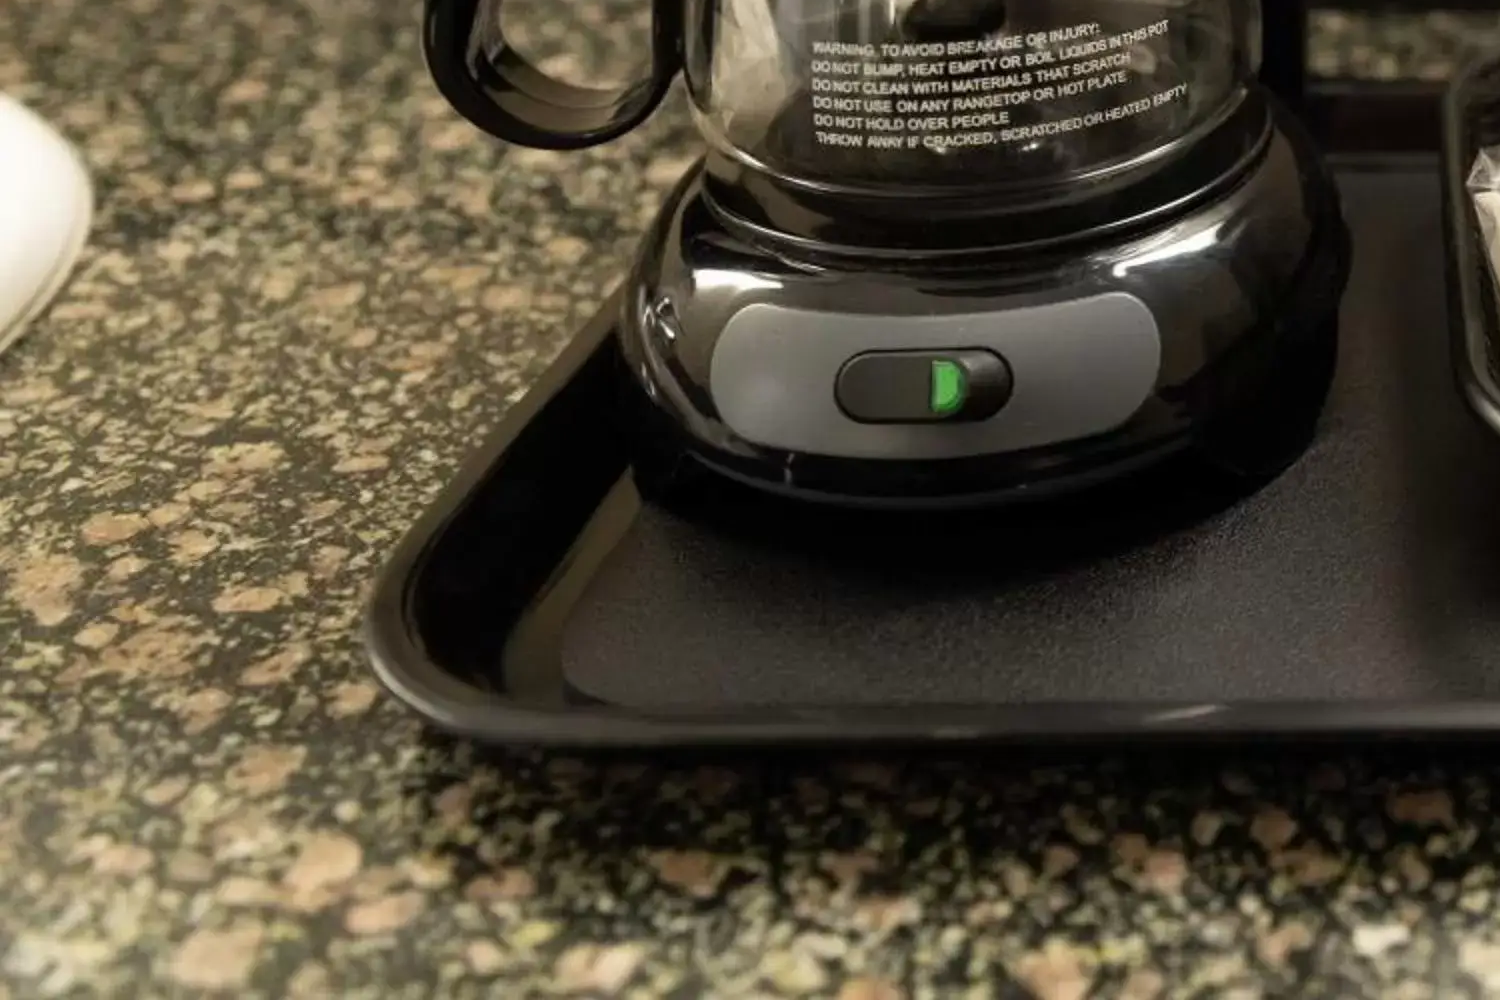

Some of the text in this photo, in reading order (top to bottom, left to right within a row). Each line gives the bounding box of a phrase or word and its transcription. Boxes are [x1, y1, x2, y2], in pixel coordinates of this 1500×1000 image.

[811, 60, 831, 74] DO
[831, 61, 861, 75] NOT
[908, 61, 946, 76] HEAT
[949, 57, 998, 75] EMPTY
[999, 56, 1022, 70] OR
[1025, 51, 1056, 67] BOIL
[1059, 40, 1107, 60] LIQUIDS
[1109, 35, 1122, 48] IN
[1122, 27, 1147, 44] THIS
[1148, 19, 1170, 37] POT
[880, 43, 899, 57] TO
[901, 42, 945, 57] AVOID
[947, 36, 1023, 56] BREAKAGE
[1026, 32, 1048, 48] OR
[812, 52, 1131, 95] DO NOT CLEAN WITH MATERIALS THAT SCRATCH
[812, 70, 1128, 113] DO NOT USE ON ANY RANGETOP OR HOT PLATE
[813, 112, 1010, 131] DO NOT HOLD OVER PEOPLE
[815, 82, 1188, 149] THROW AWAY IF CRACKED, SCRATCHED OR HEATED EMPTY
